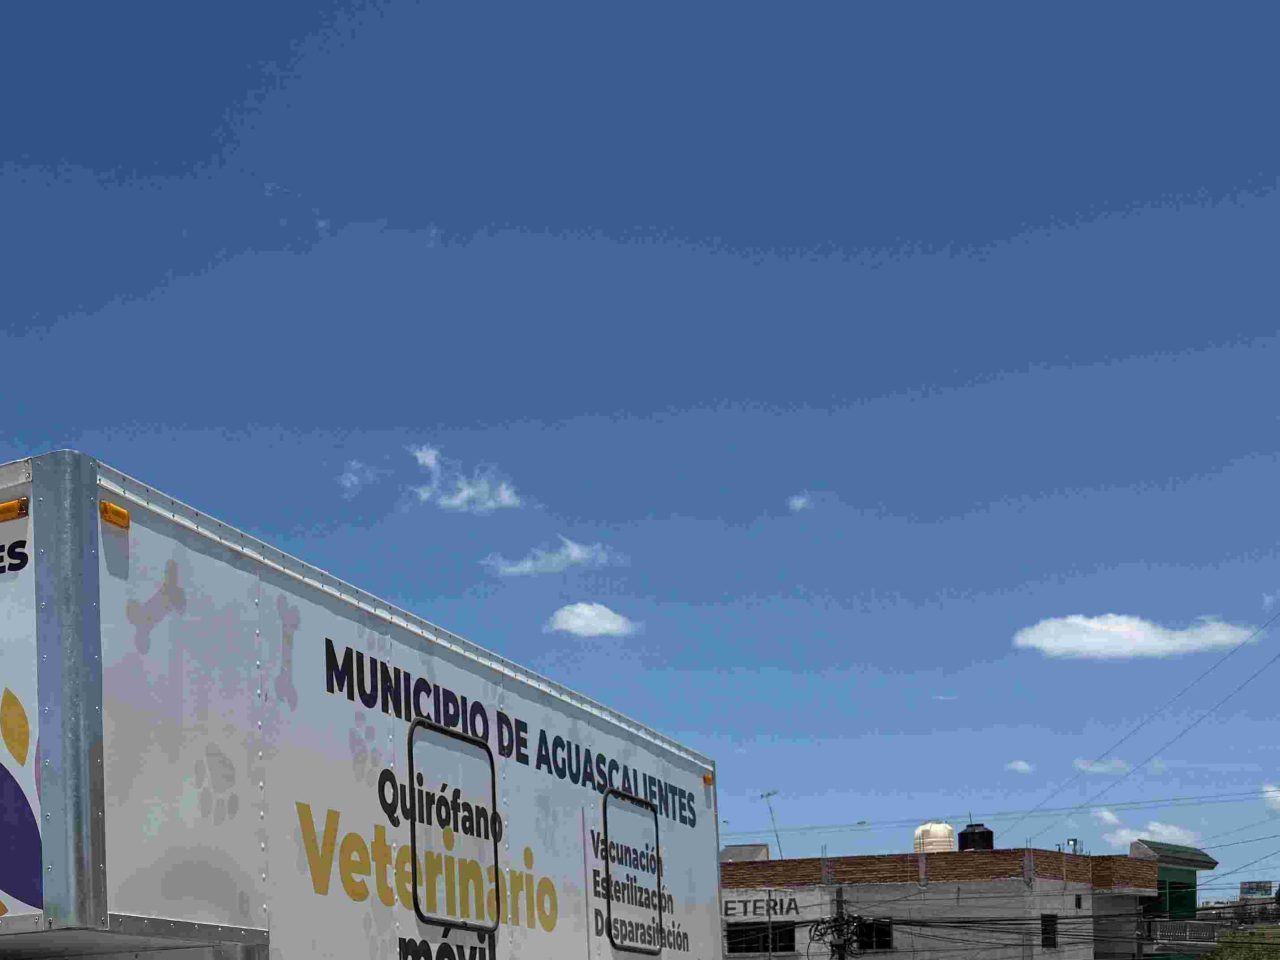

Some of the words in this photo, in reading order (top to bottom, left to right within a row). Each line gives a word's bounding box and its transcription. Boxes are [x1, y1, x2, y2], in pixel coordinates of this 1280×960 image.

[325, 637, 490, 746] MUNICIPIO
[497, 710, 529, 766] DE
[536, 728, 697, 828] AGUASCALIENTES
[378, 769, 503, 843] Quirófano
[295, 801, 558, 933] Veterinario
[593, 869, 674, 914] Esterilizacón
[724, 898, 799, 916] ETERIA
